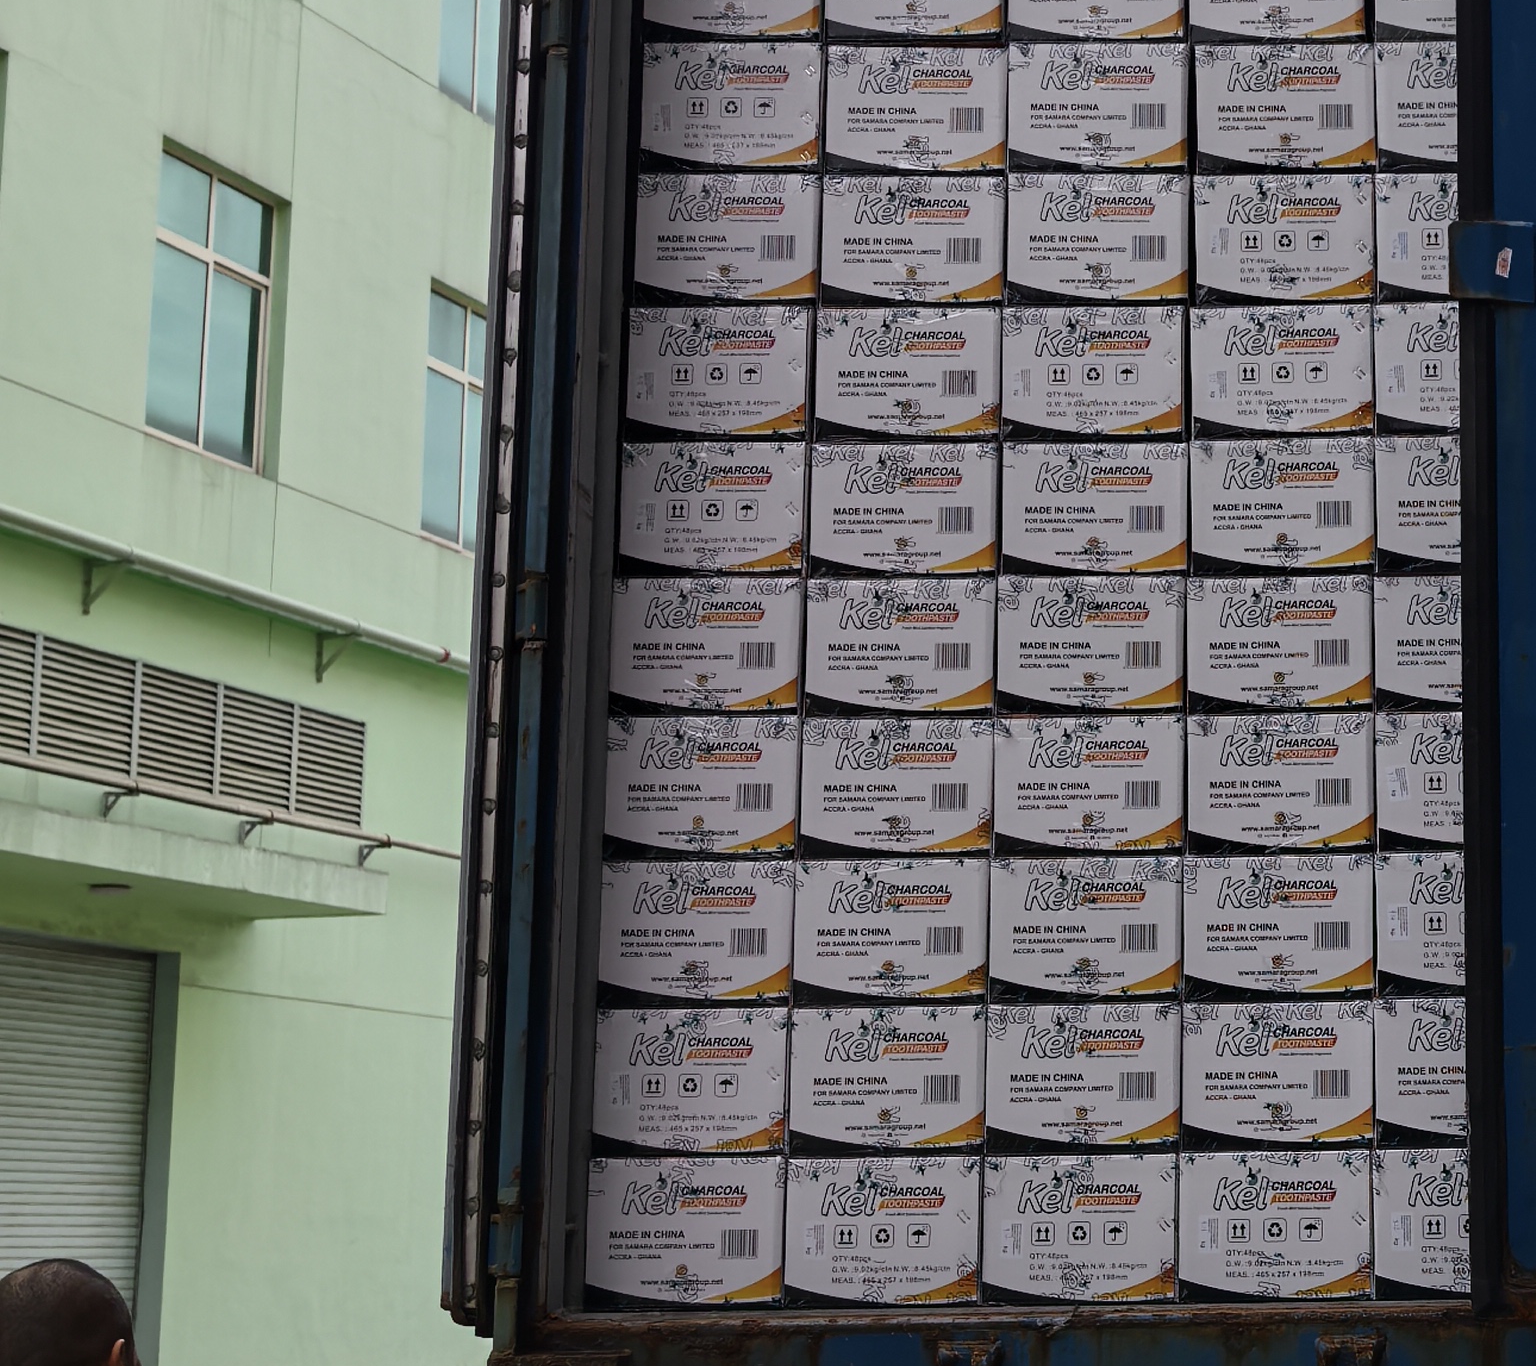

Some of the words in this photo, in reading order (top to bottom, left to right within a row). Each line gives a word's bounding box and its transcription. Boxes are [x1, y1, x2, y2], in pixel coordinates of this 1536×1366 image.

[912, 69, 972, 79] CHARCOAL
[1280, 66, 1340, 75] CHARCOAL
[858, 64, 910, 95] Kel
[1226, 62, 1279, 93] Kel
[848, 106, 874, 114] MADE
[877, 107, 886, 115] IN
[887, 107, 916, 115] CHINA
[1218, 105, 1244, 113] MADE
[1246, 105, 1256, 113] IN
[1257, 105, 1286, 113] CHINA
[909, 199, 969, 209] CHARCOAL
[854, 194, 906, 226] Kel
[844, 237, 871, 245] MADE
[884, 238, 913, 246] CHINA
[1090, 466, 1152, 476] CHARCOAL
[1035, 461, 1088, 494] Kel
[1025, 506, 1052, 514] MADE
[1054, 506, 1064, 514] IN
[1065, 506, 1095, 514] CHINA
[1086, 601, 1148, 611] CHARCOAL
[1274, 600, 1336, 609] CHARCOAL
[1030, 596, 1084, 629] Kel
[1218, 596, 1273, 628] Kel
[1020, 641, 1047, 650] MADE
[1050, 642, 1059, 650] IN
[1061, 641, 1091, 650] CHINA
[1210, 642, 1237, 650] MADE
[1239, 642, 1249, 650] IN
[1250, 641, 1280, 649] CHINA
[893, 742, 956, 752] CHARCOAL
[1085, 740, 1148, 750] CHARCOAL
[1275, 738, 1338, 748] CHARCOAL
[835, 737, 890, 771] Kel
[1028, 736, 1083, 769] Kel
[1219, 734, 1274, 767] Kel
[824, 784, 852, 792] MADE
[854, 784, 864, 792] IN
[866, 784, 897, 792] CHINA
[1018, 782, 1046, 791] MADE
[1048, 782, 1058, 791] IN
[1059, 782, 1090, 790] CHINA
[1210, 781, 1238, 789] MADE
[1240, 781, 1250, 789] IN
[1251, 780, 1281, 788] CHINA
[1273, 880, 1337, 890] CHARCOAL
[691, 885, 755, 896] CHARCOAL
[1216, 876, 1272, 910] Kel
[633, 880, 689, 915] Kel
[621, 928, 650, 937] MADE
[652, 929, 662, 937] IN
[663, 928, 695, 937] CHINA
[1207, 923, 1235, 932] MADE
[1237, 923, 1247, 932] IN
[1248, 923, 1279, 931] CHINA
[883, 1032, 947, 1042] CHARCOAL
[1273, 1027, 1336, 1037] CHARCOAL
[1215, 1023, 1271, 1057] Kel
[825, 1028, 881, 1063] Kel
[814, 1077, 842, 1085] MADE
[845, 1077, 855, 1085] IN
[856, 1076, 888, 1085] CHINA
[1205, 1072, 1233, 1080] MADE
[1236, 1072, 1246, 1080] IN
[1247, 1071, 1278, 1080] CHINA
